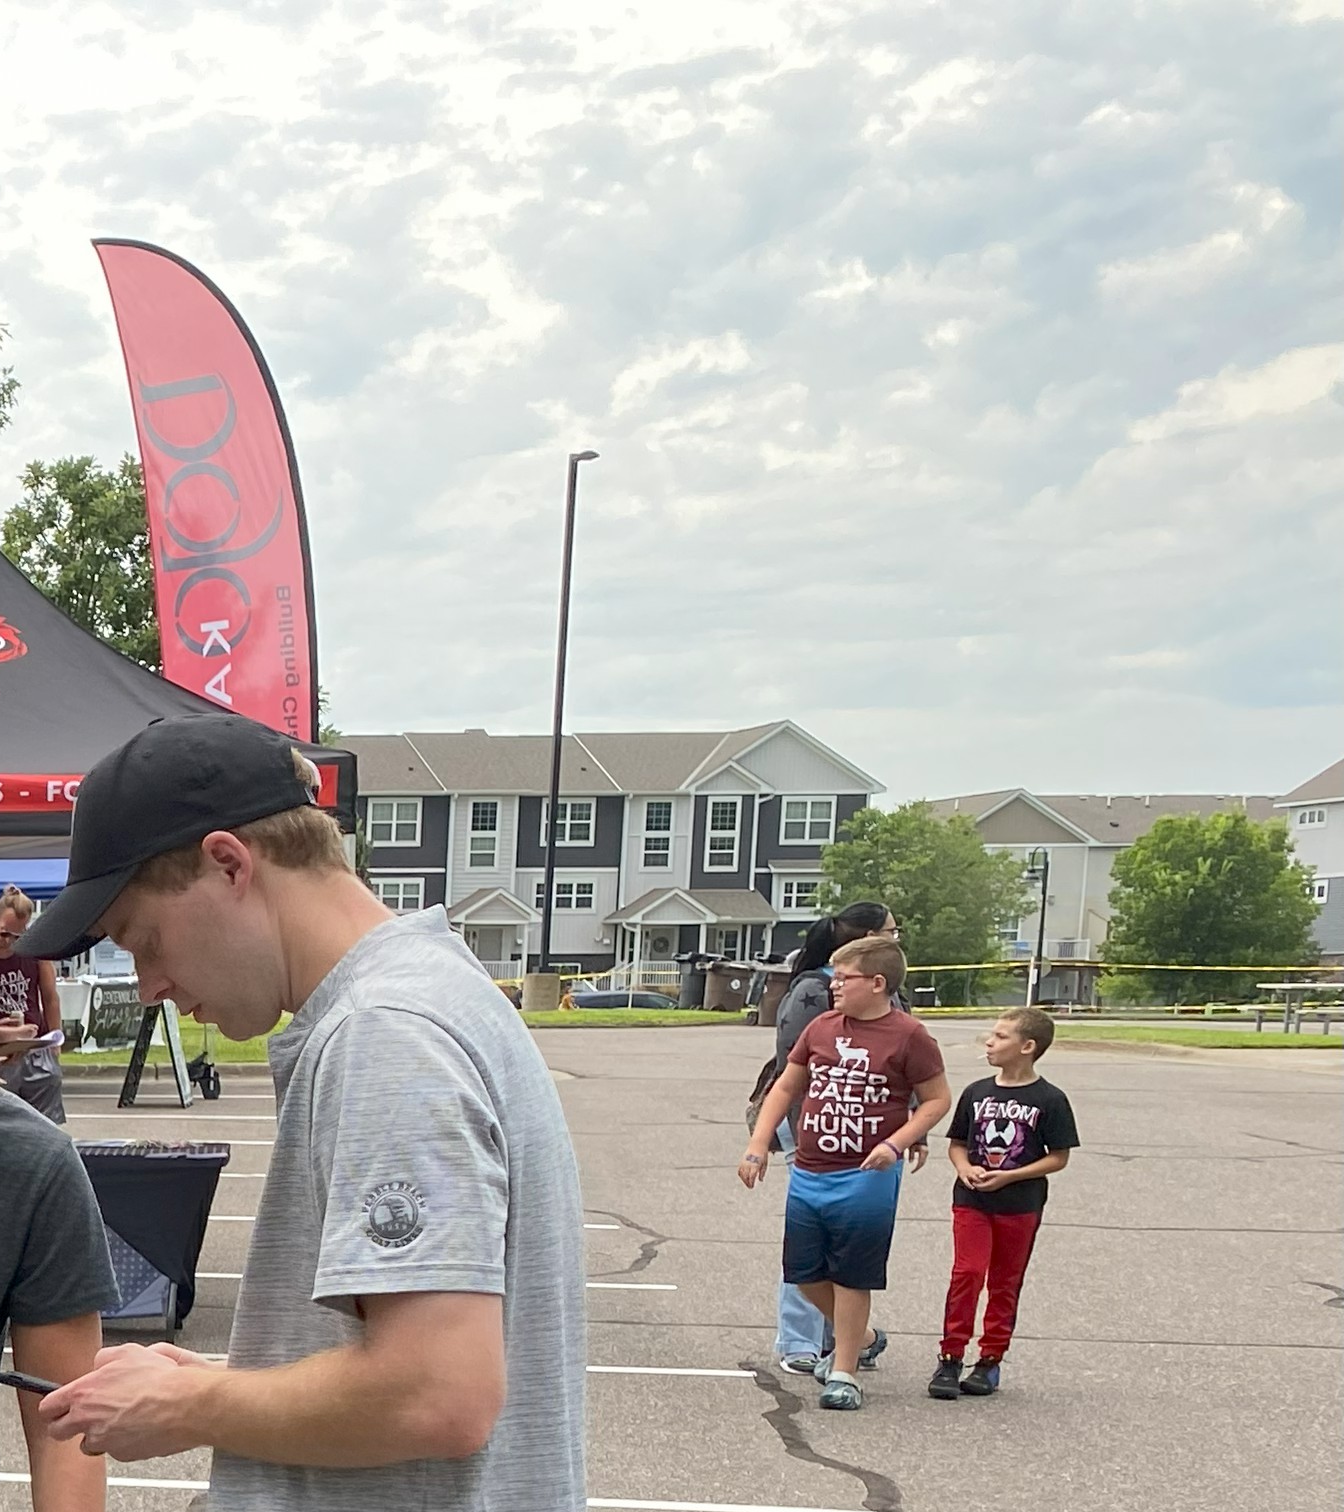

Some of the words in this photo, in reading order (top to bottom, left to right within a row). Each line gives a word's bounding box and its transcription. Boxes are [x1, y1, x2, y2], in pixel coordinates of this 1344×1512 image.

[808, 1080, 890, 1103] CALM
[820, 1102, 864, 1116] AND
[973, 1096, 1041, 1131] VENOM
[803, 1112, 884, 1135] HUNT
[818, 1134, 864, 1153] ON
